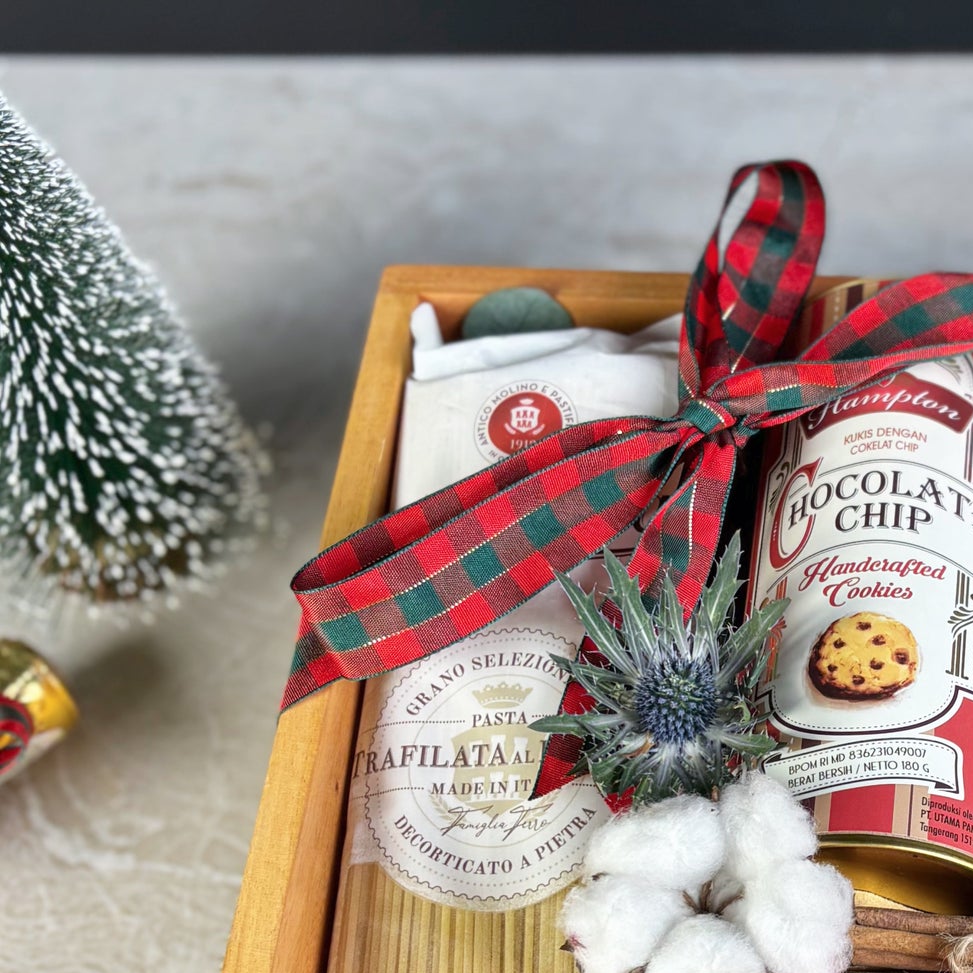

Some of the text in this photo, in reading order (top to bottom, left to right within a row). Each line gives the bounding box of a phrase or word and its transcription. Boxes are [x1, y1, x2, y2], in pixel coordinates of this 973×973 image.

[478, 383, 549, 446] ANTICO MOLINO E
[808, 389, 961, 430] Hampton
[843, 427, 928, 446] KUKIS DENGAN
[849, 440, 919, 455] COKELAT CHIP
[834, 502, 934, 534] CHIP
[798, 555, 947, 591] Handcrafted
[822, 577, 913, 607] Cookies
[406, 652, 569, 716] GRANO SELEZION
[472, 710, 528, 728] PASTA
[352, 743, 509, 779] TRAFILATA
[512, 750, 535, 765] AL
[788, 760, 930, 788] BERAT BERSIH NETTO 180 G
[789, 760, 818, 776] BPOM
[831, 753, 846, 765] MD
[430, 781, 508, 795] MADE IN
[921, 796, 962, 815] Diproduksi
[934, 809, 961, 829] UTAMA
[394, 806, 597, 875] DECORTICATO A PIETRA
[920, 821, 959, 843] Tangerang
